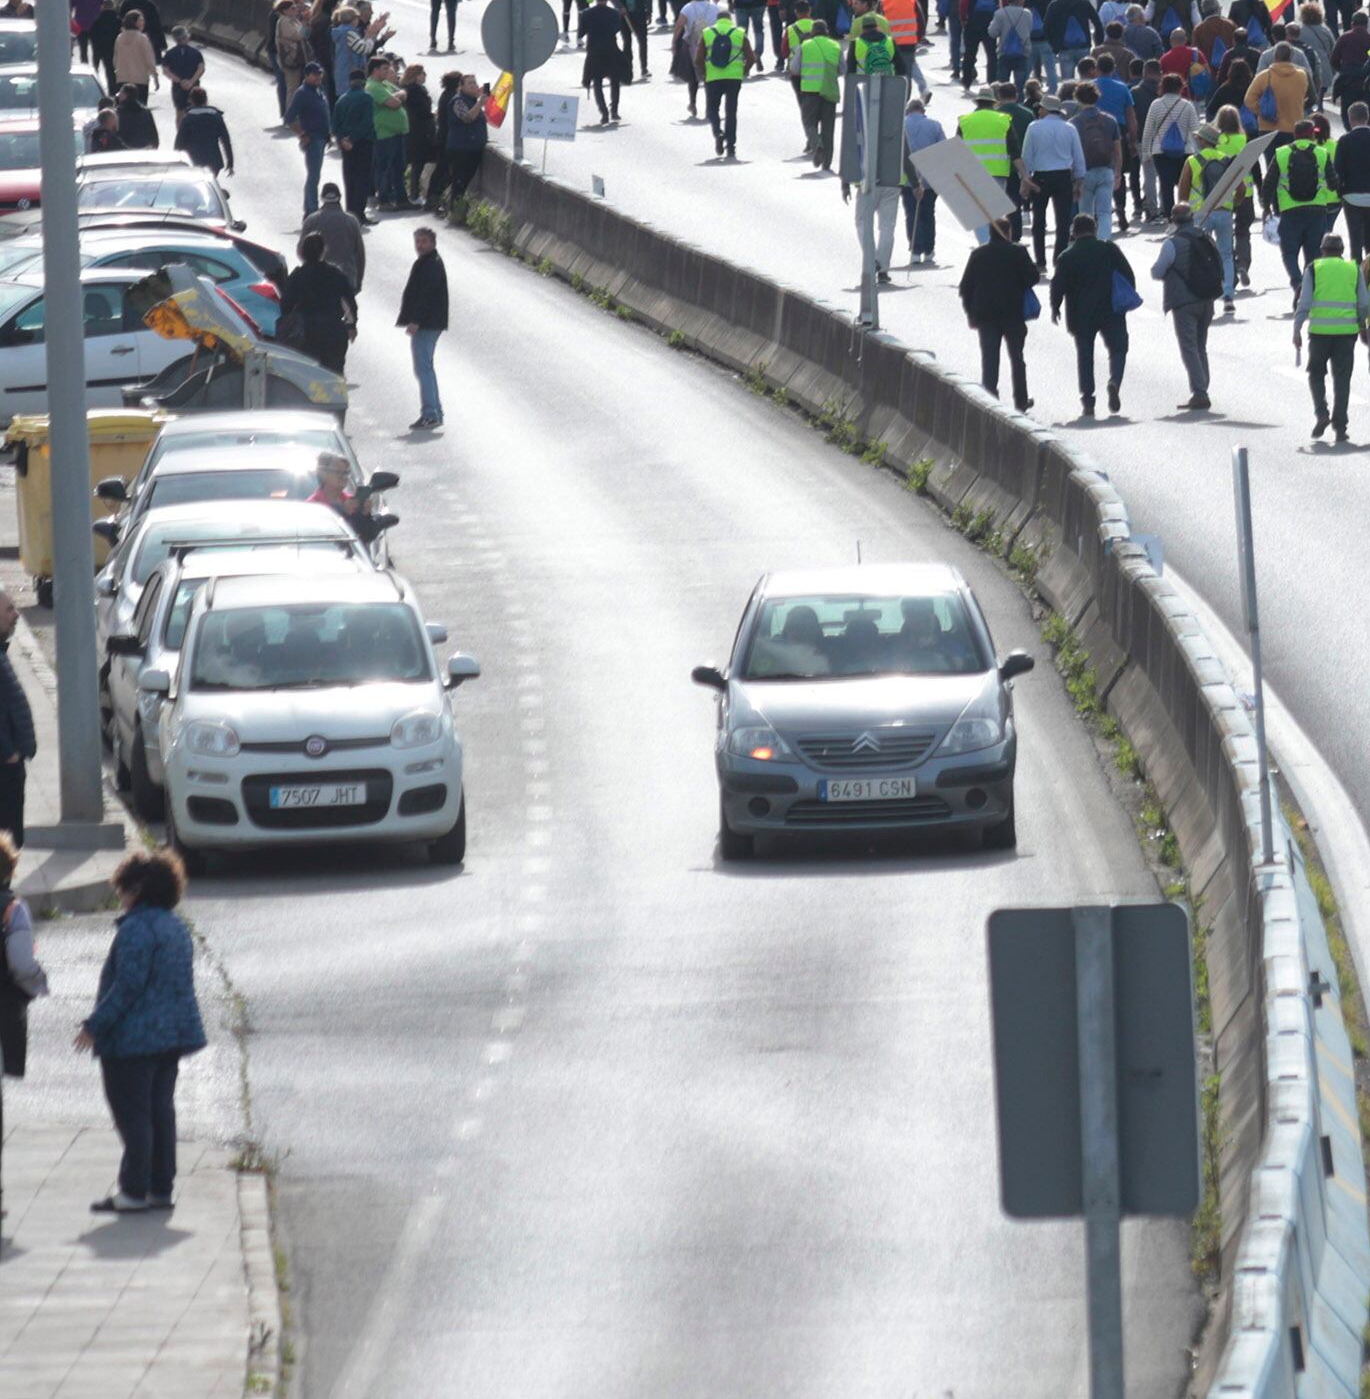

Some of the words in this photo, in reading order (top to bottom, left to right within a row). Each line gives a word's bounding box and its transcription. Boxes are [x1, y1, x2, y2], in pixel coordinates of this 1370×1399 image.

[281, 788, 320, 806] 7507
[329, 786, 357, 803] JHT
[831, 783, 872, 798] 6491
[879, 780, 912, 797] CSN
